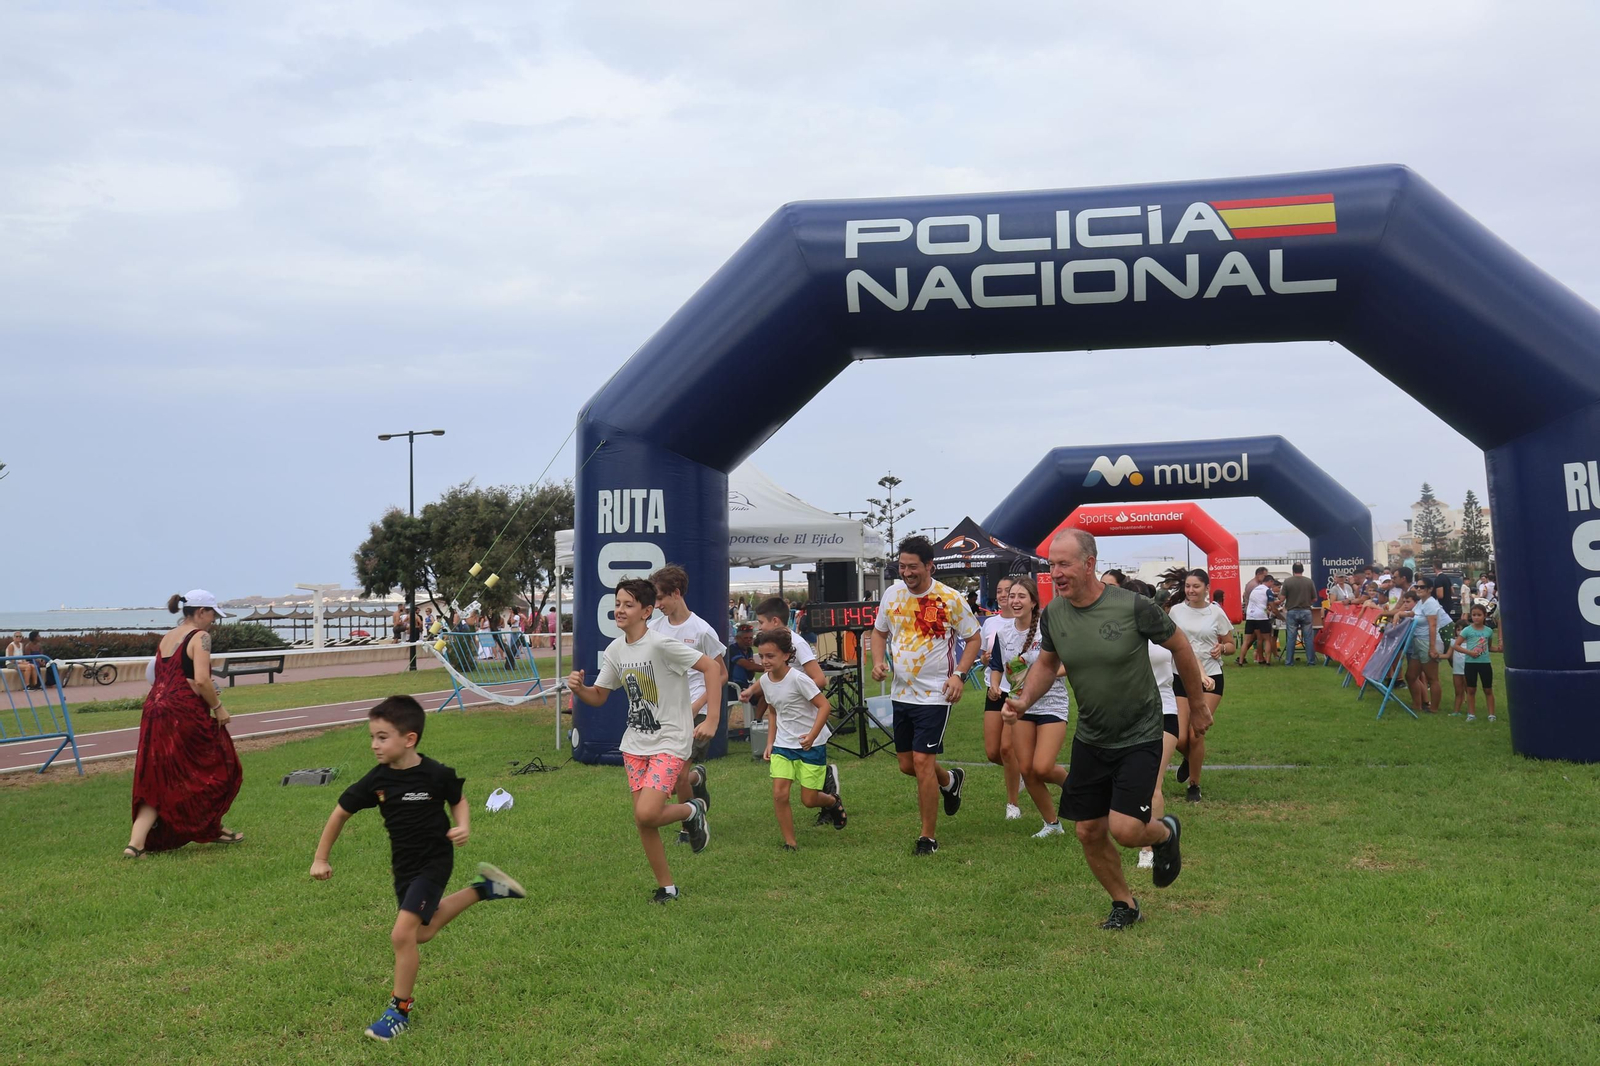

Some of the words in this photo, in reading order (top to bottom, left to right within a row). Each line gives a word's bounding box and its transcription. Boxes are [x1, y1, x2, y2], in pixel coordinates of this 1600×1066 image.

[846, 249, 1337, 313] NACIONAL
[1154, 453, 1248, 489] mupol
[598, 489, 666, 534] RUTA
[1079, 513, 1113, 525] Sports
[1130, 511, 1184, 523] Santander
[774, 533, 789, 544] de
[794, 533, 807, 544] El
[811, 533, 844, 547] Ejido
[1322, 557, 1364, 567] fundación
